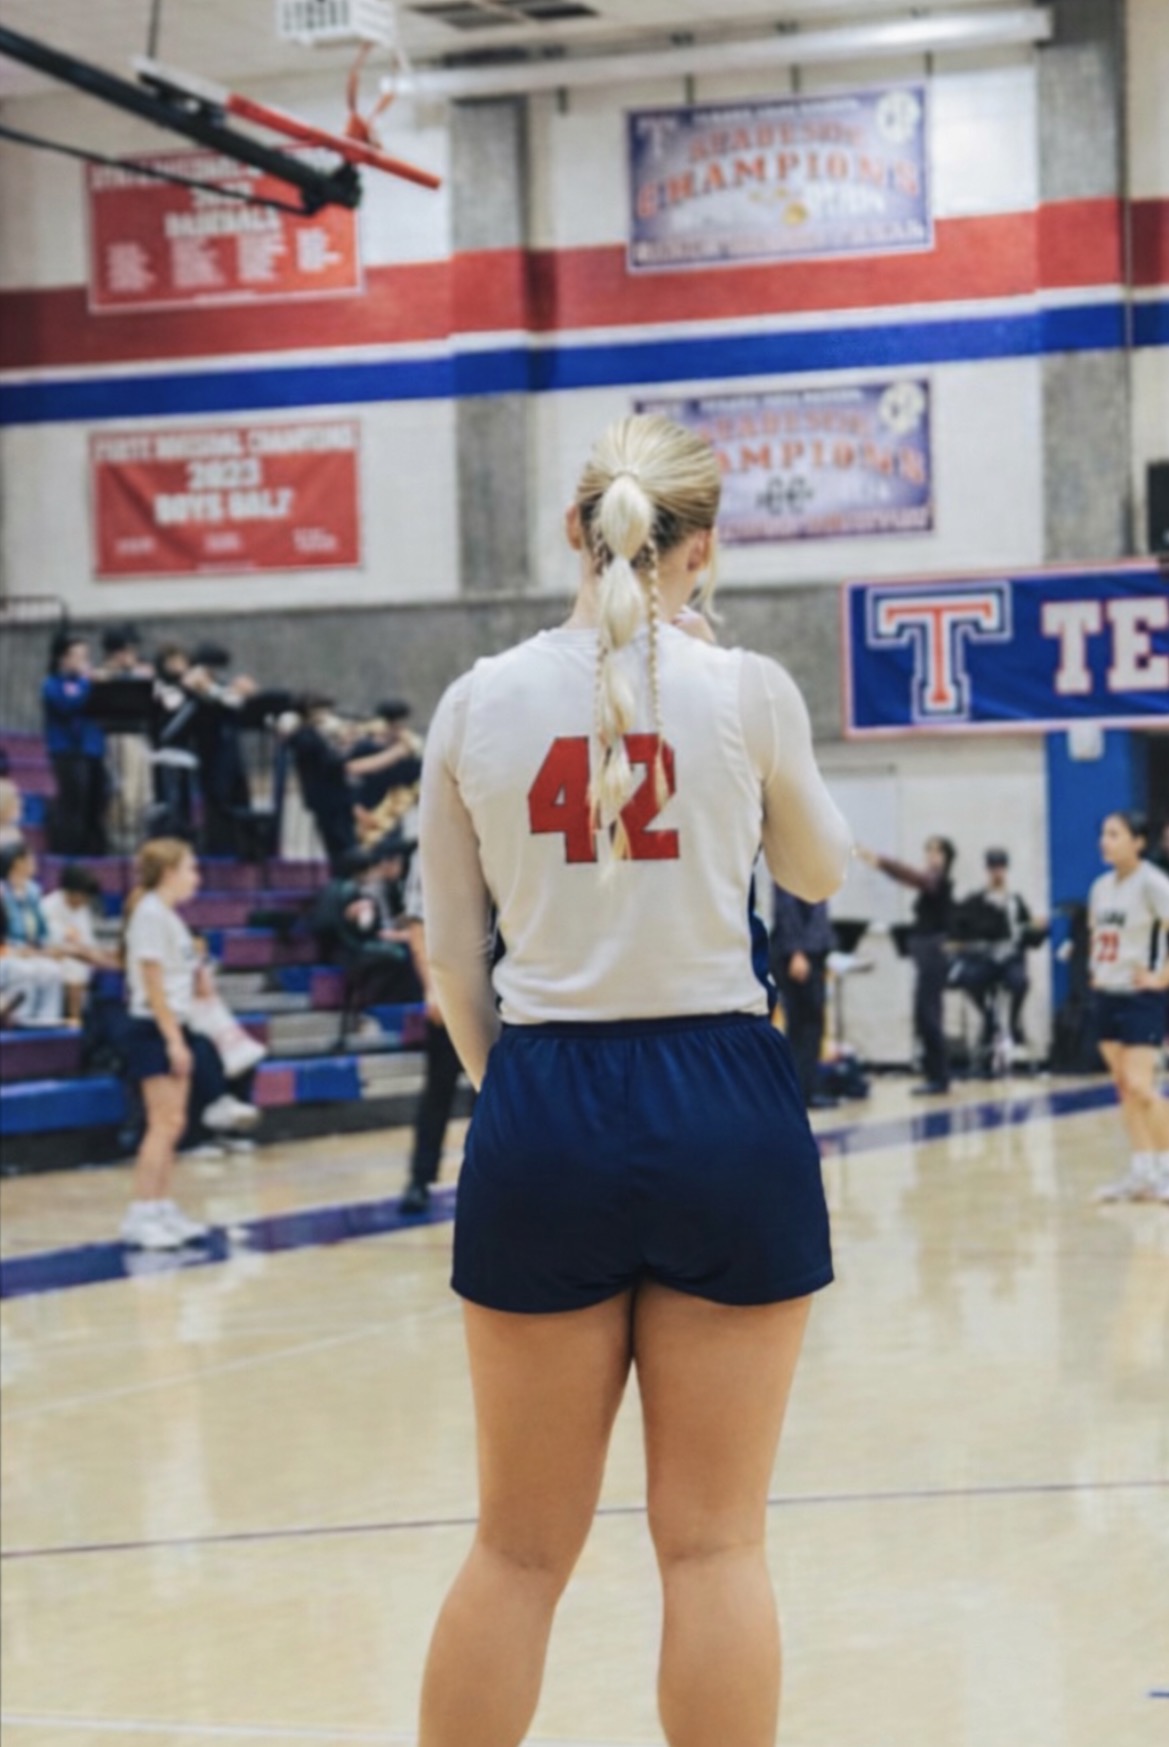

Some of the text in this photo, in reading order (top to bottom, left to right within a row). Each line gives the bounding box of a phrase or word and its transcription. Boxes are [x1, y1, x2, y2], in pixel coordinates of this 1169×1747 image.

[638, 150, 919, 218] CHAMPIONS
[714, 438, 925, 487] AMPIONS
[866, 580, 1013, 723] T
[527, 733, 680, 864] 42
